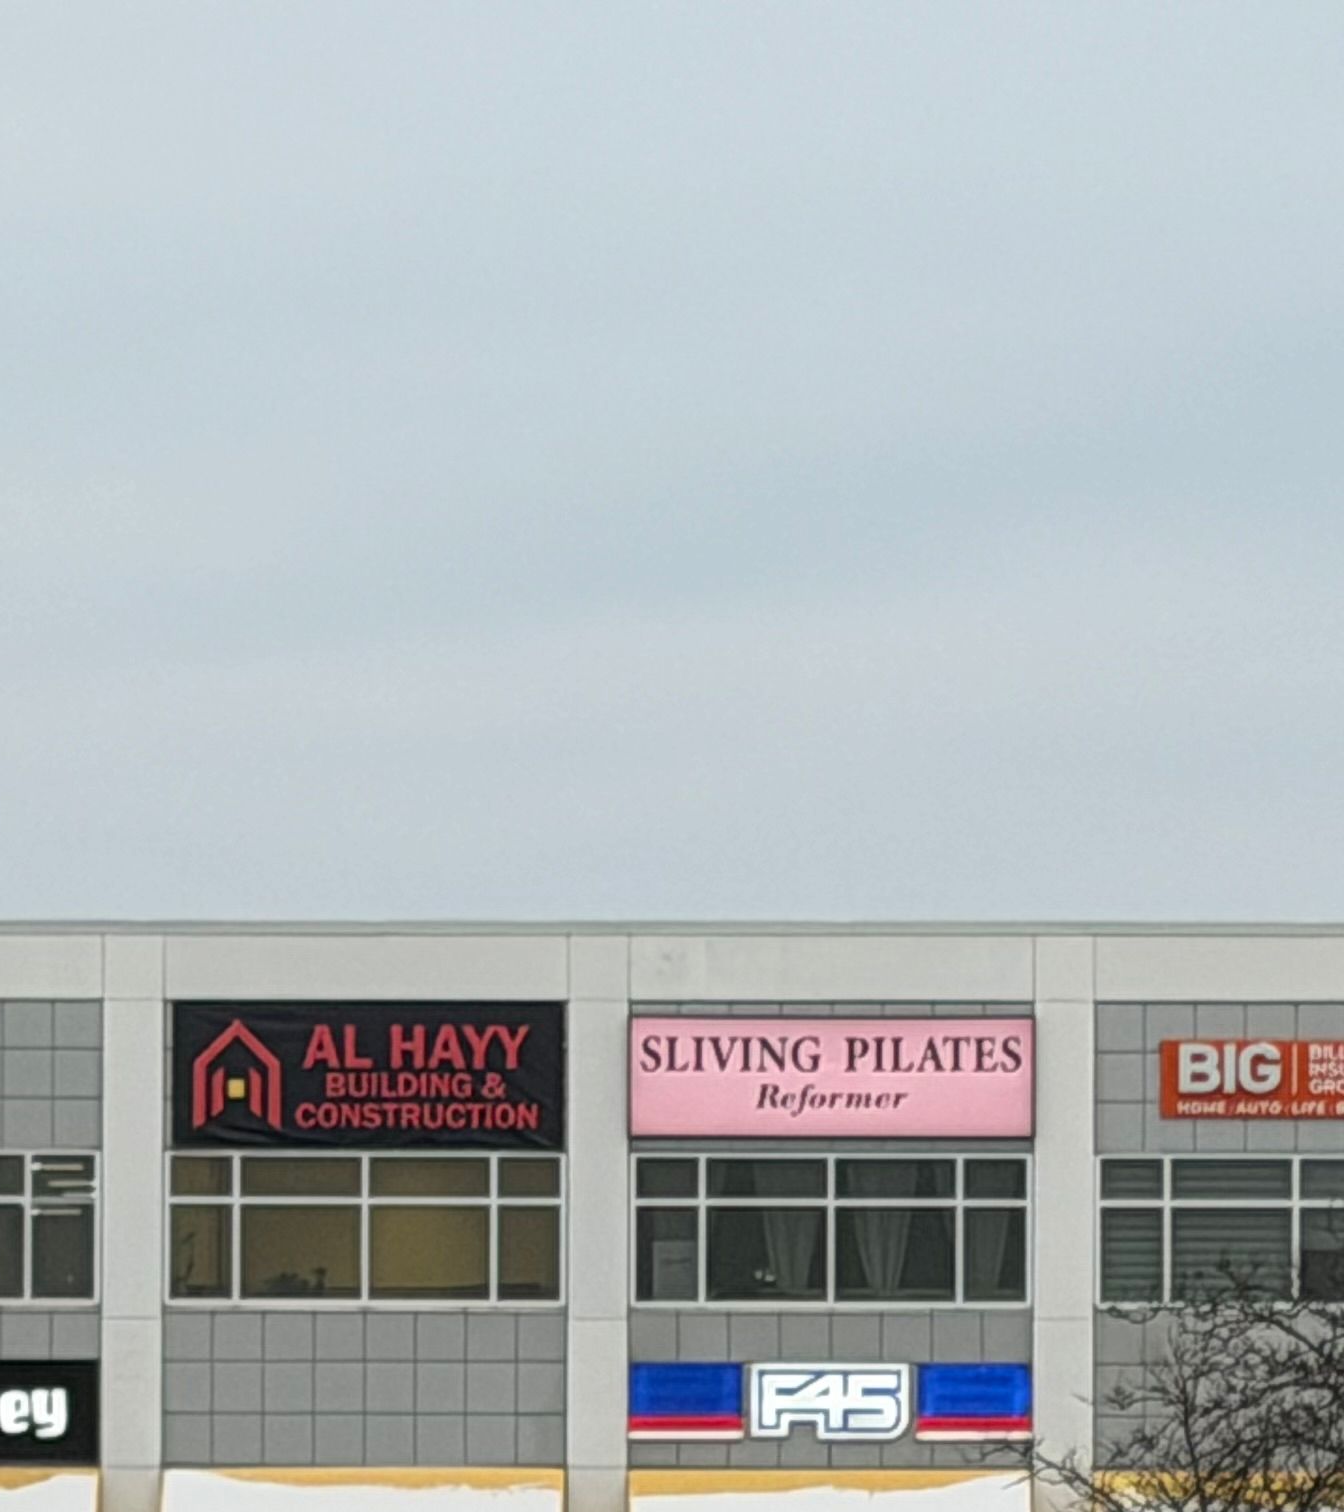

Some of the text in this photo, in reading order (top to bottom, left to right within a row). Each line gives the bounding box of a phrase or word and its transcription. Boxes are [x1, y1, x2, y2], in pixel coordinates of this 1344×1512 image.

[303, 1024, 530, 1070] AL HAYY
[639, 1035, 1023, 1073] SLIVING PILATES
[325, 1072, 507, 1098] BUILDING &
[1178, 1042, 1282, 1094] BIG
[294, 1102, 540, 1129] CONSTRUCTION
[756, 1083, 909, 1118] Reformer
[1176, 1101, 1227, 1115] HOME
[1235, 1101, 1282, 1115] AUTO
[1291, 1102, 1326, 1115] LIFE
[758, 1368, 903, 1434] F45
